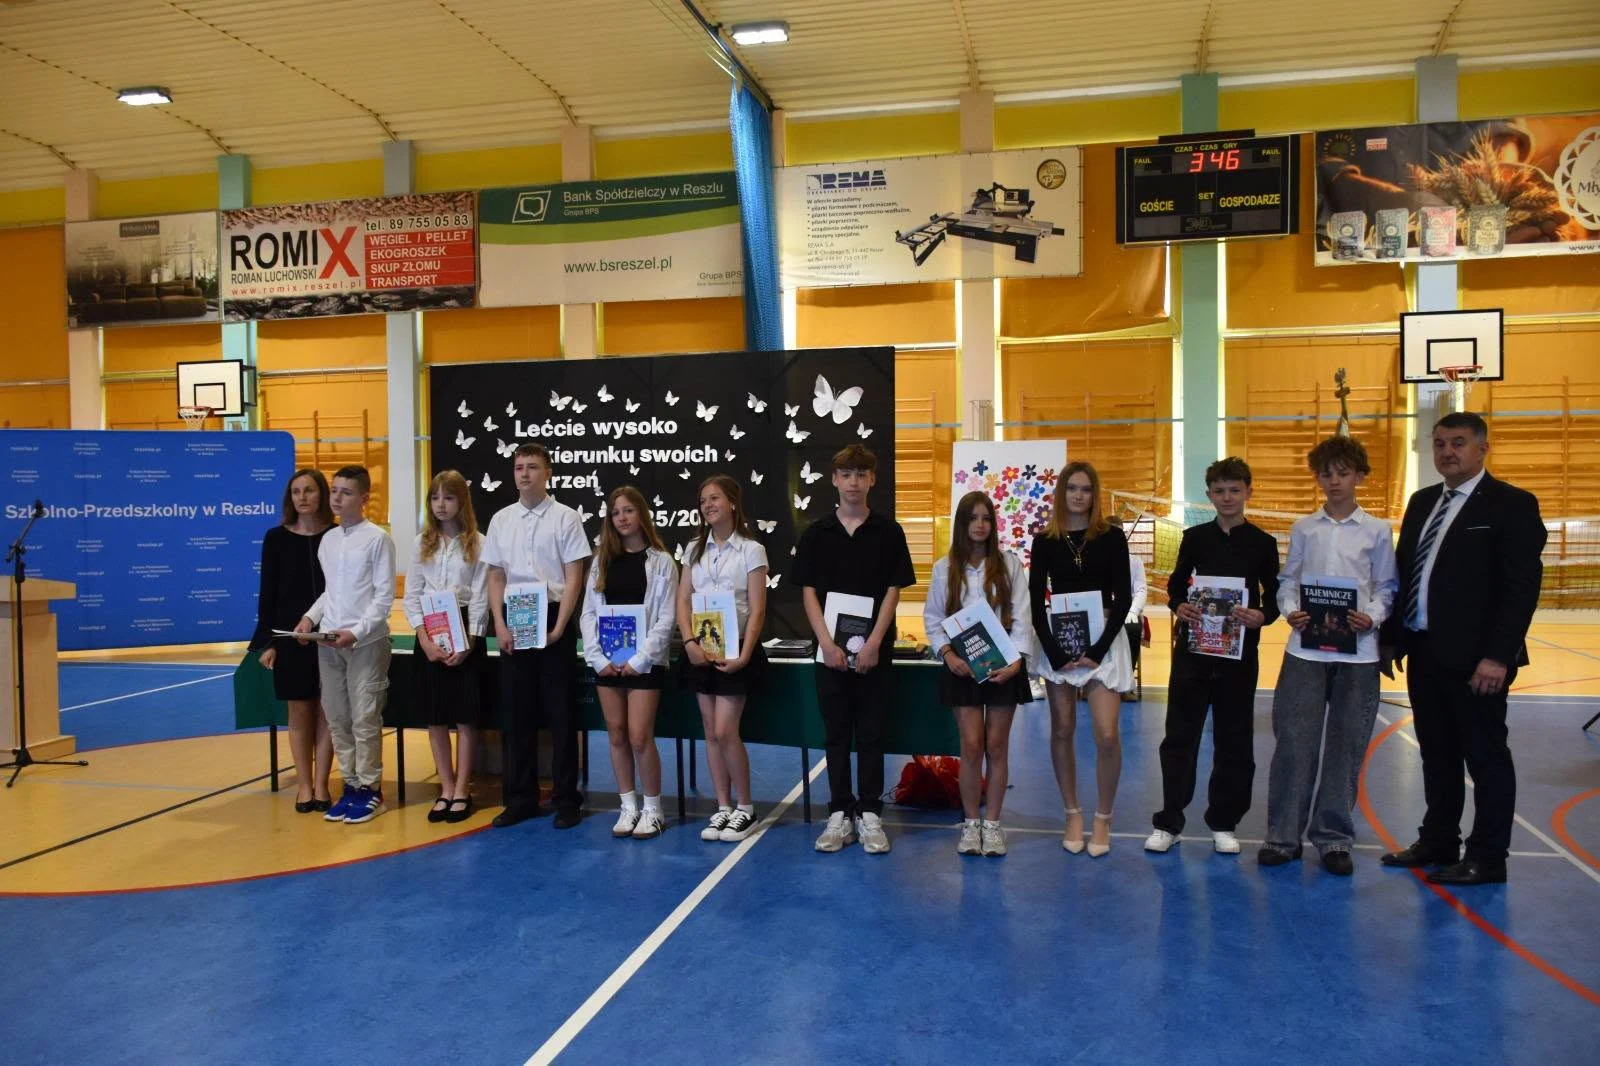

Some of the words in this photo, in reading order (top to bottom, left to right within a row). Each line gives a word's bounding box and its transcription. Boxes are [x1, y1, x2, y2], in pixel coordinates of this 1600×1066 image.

[1174, 145, 1193, 153] CZAS
[1223, 142, 1239, 150] GRY
[1261, 148, 1281, 156] FAUL
[1134, 157, 1152, 165] FAUL
[822, 169, 887, 190] REMA
[563, 189, 592, 203] Bank
[595, 186, 667, 203] Spółdzielczy
[669, 186, 679, 196] w
[683, 182, 724, 195] Reszlu
[1198, 192, 1215, 200] SET
[1139, 199, 1175, 213] GOŚCIE
[1219, 193, 1281, 208] GOSPODARZE
[563, 208, 583, 218] Grupa
[584, 207, 600, 216] BPS
[366, 220, 385, 231] tel.
[389, 218, 403, 230] 89
[409, 217, 430, 229] 755
[435, 215, 449, 227] 05
[454, 214, 469, 226] 83
[369, 234, 412, 248] WĘGIEL
[426, 230, 468, 243] PELLET
[230, 226, 360, 280] ROMIX
[370, 246, 447, 260] EKOGROSZEK
[370, 262, 400, 274] SKUP
[402, 260, 441, 272] ZŁOMU
[564, 256, 673, 274] www.bsreszel.pl
[231, 272, 262, 285] ROMAN
[264, 268, 317, 283] LUCHOWSKI
[371, 274, 438, 288] TRANSPORT
[699, 272, 723, 281] Grupa
[725, 270, 743, 279] BPS
[231, 279, 361, 296] www.romix.reszel.pl
[592, 416, 678, 440] wysoko
[639, 444, 718, 464] swoich
[545, 470, 599, 489] rzeń
[202, 505, 217, 516] w
[221, 501, 275, 516] Reszlu
[1303, 587, 1353, 600] TAJEMNICZE
